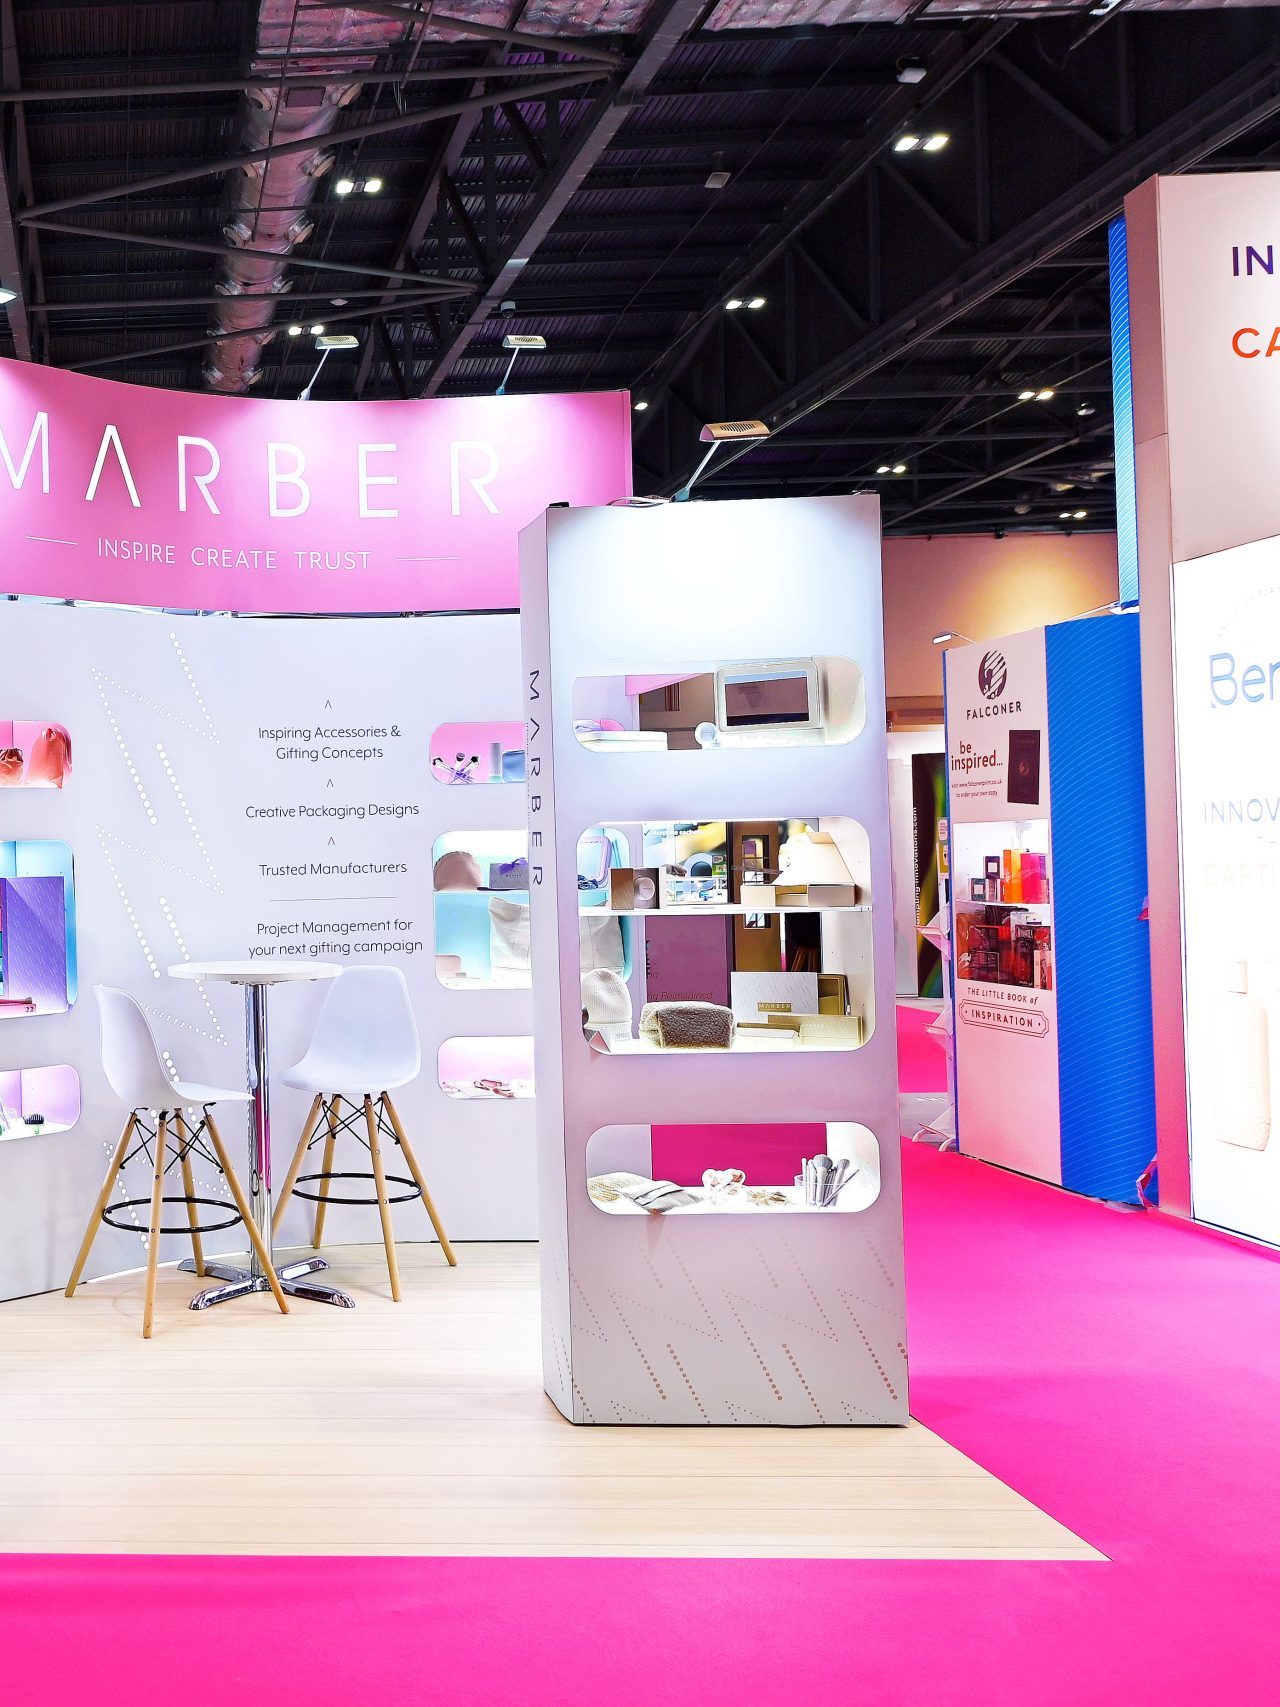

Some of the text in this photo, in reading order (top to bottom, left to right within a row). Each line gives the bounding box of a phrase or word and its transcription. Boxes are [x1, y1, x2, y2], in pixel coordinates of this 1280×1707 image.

[96, 537, 373, 571] INSPIRE CREATE TRUST
[966, 701, 1022, 720] FALCONER
[258, 725, 402, 742] Inspiring Accessories &
[276, 746, 384, 763] Gifting Concepts
[959, 741, 972, 754] be
[951, 750, 1003, 775] inspired...
[529, 669, 543, 885] MARBER
[245, 803, 419, 820] Creative Packaging Designs
[259, 862, 408, 877] Trusted Manufacturers
[257, 918, 413, 937] Project Management for
[248, 938, 423, 959] your next gifting campaign
[968, 987, 979, 996] THE
[982, 989, 1005, 1000] LITTLE
[1007, 992, 1027, 1003] BOOK
[971, 1010, 1034, 1028] INSPIRATION
